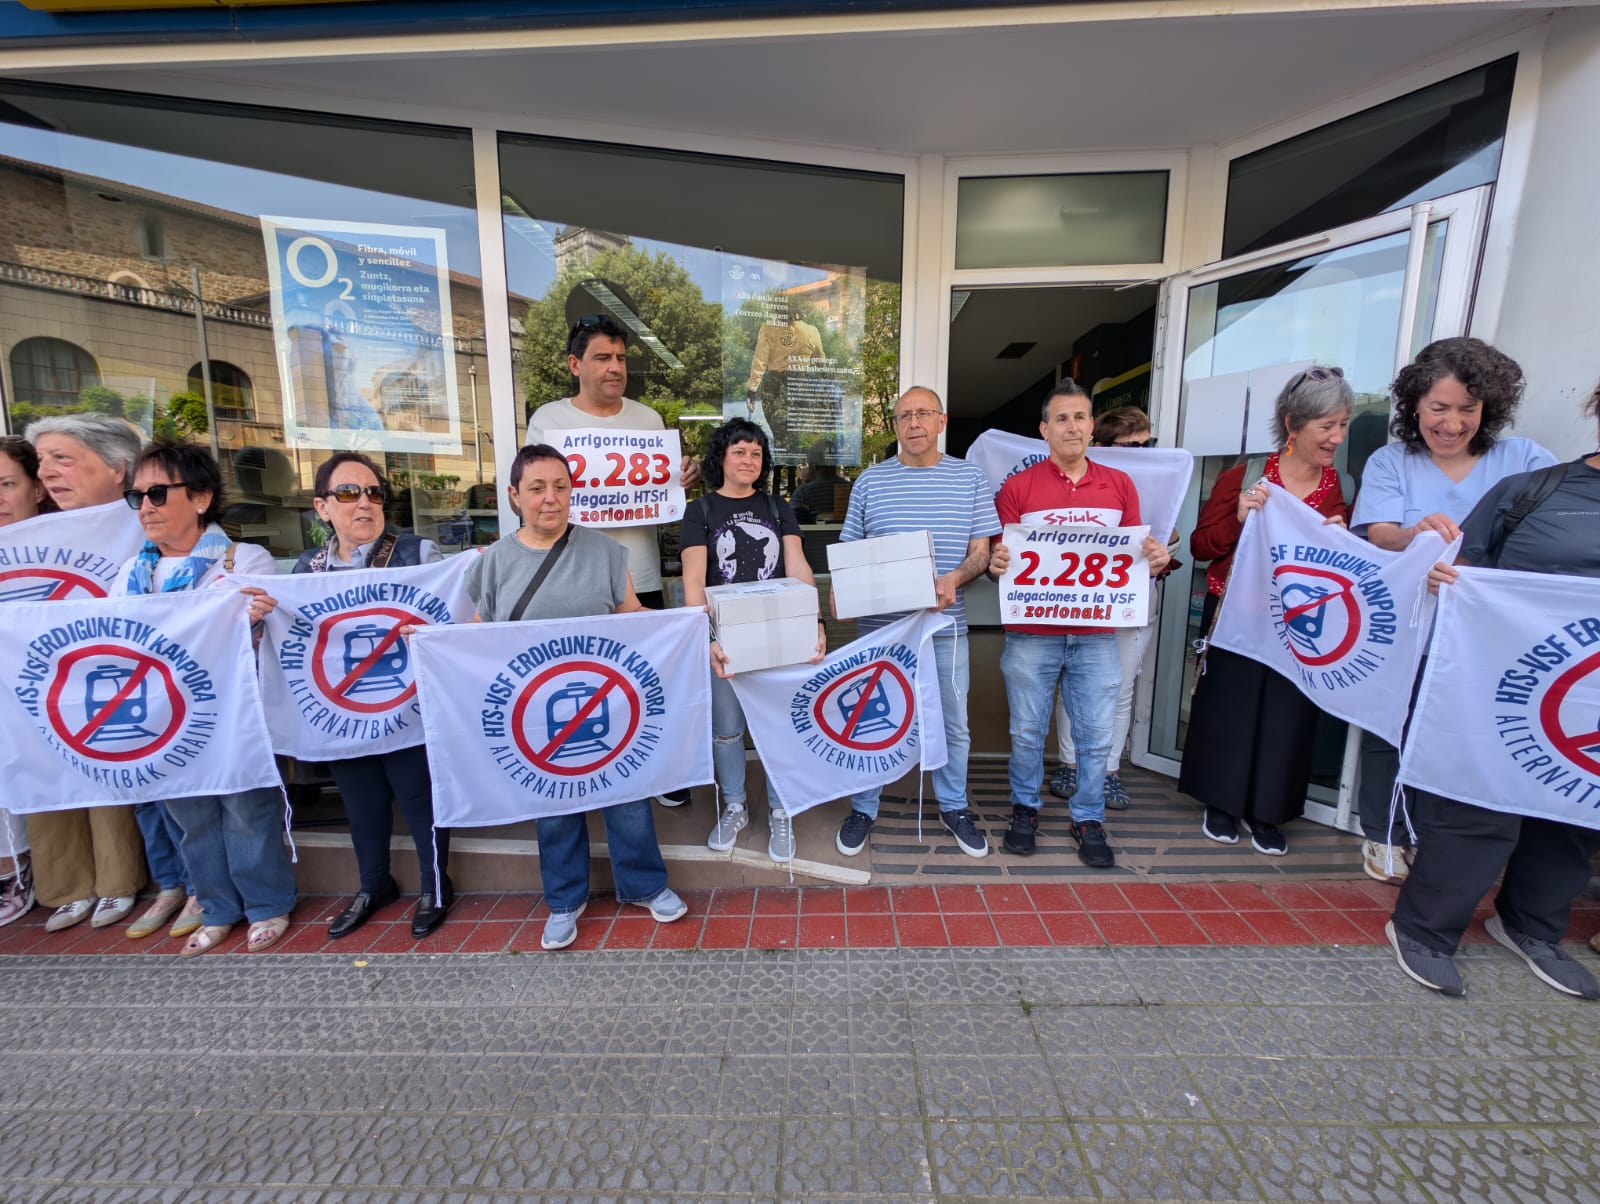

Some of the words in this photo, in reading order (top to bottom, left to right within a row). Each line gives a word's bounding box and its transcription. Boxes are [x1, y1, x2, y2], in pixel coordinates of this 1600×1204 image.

[357, 243, 387, 256] Fibra,
[389, 245, 417, 256] móvil
[358, 257, 366, 267] y
[367, 258, 412, 268] sencillez
[359, 270, 392, 282] Zuntz,
[361, 283, 412, 295] mugikorra
[413, 286, 430, 294] eta
[751, 292, 774, 302] donde
[774, 294, 789, 303] está
[362, 292, 425, 304] sinpletasuna
[761, 301, 789, 311] Correos
[735, 308, 763, 318] Correos
[787, 354, 801, 363] AXA
[806, 365, 836, 374] babesten
[563, 434, 664, 449] Arrigorriagak
[566, 452, 671, 488] 2.283
[570, 492, 630, 508] alegazio
[634, 488, 668, 504] HTSri
[580, 503, 660, 522] zorionak!
[1026, 530, 1131, 547] Arrigorriaga
[1013, 550, 1134, 588] 2.283
[297, 583, 421, 621] ERDIGUNETIK
[1007, 590, 1078, 603] alegaciones
[1081, 593, 1090, 603] a
[1093, 592, 1105, 603] la
[1109, 593, 1137, 604] VSF
[1024, 603, 1113, 620] zorionak!
[29, 616, 156, 659] ERDIGUNETIK
[149, 634, 217, 703] KANPORA
[1495, 634, 1572, 705] HTS-VSF
[481, 672, 516, 738] HTS-VSF
[507, 635, 627, 679] ERDIGUNETIK
[621, 650, 666, 717] KANPORA
[790, 691, 813, 734] HTS-VSF
[804, 734, 908, 774] ALTERNATIBAK
[489, 745, 613, 800] ALTERNATIBAK
